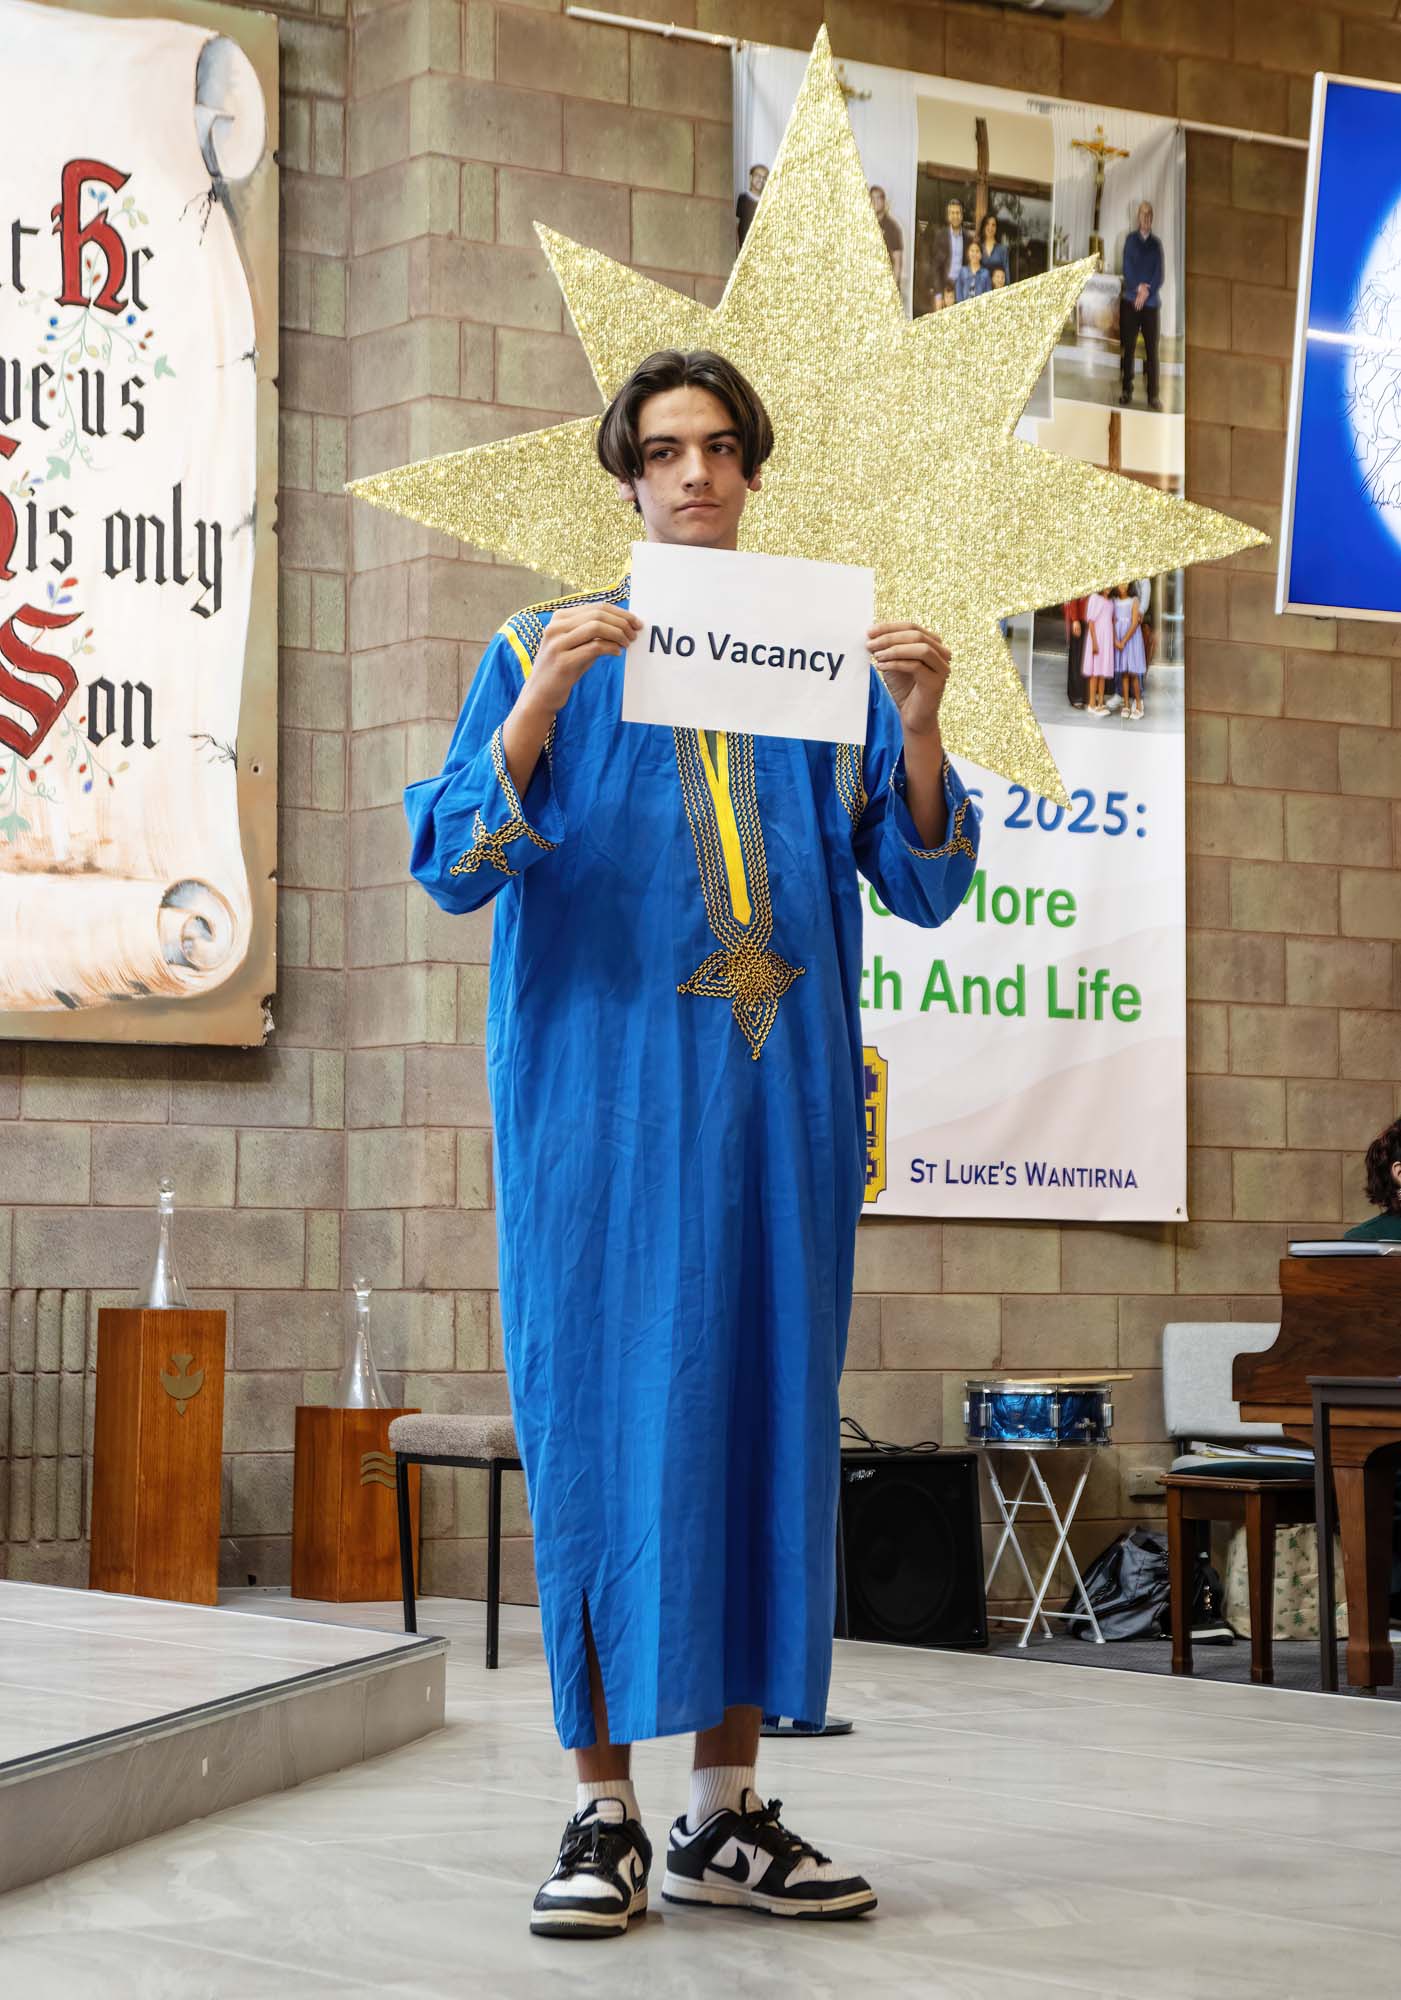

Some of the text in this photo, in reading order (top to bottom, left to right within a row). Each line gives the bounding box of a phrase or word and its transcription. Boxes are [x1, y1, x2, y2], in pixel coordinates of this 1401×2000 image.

[78, 367, 145, 441] us
[103, 480, 222, 619] only
[649, 625, 845, 681] No Vacancy
[1004, 783, 1147, 838] 2025:
[919, 959, 1026, 1017] And
[1047, 965, 1142, 1022] Life
